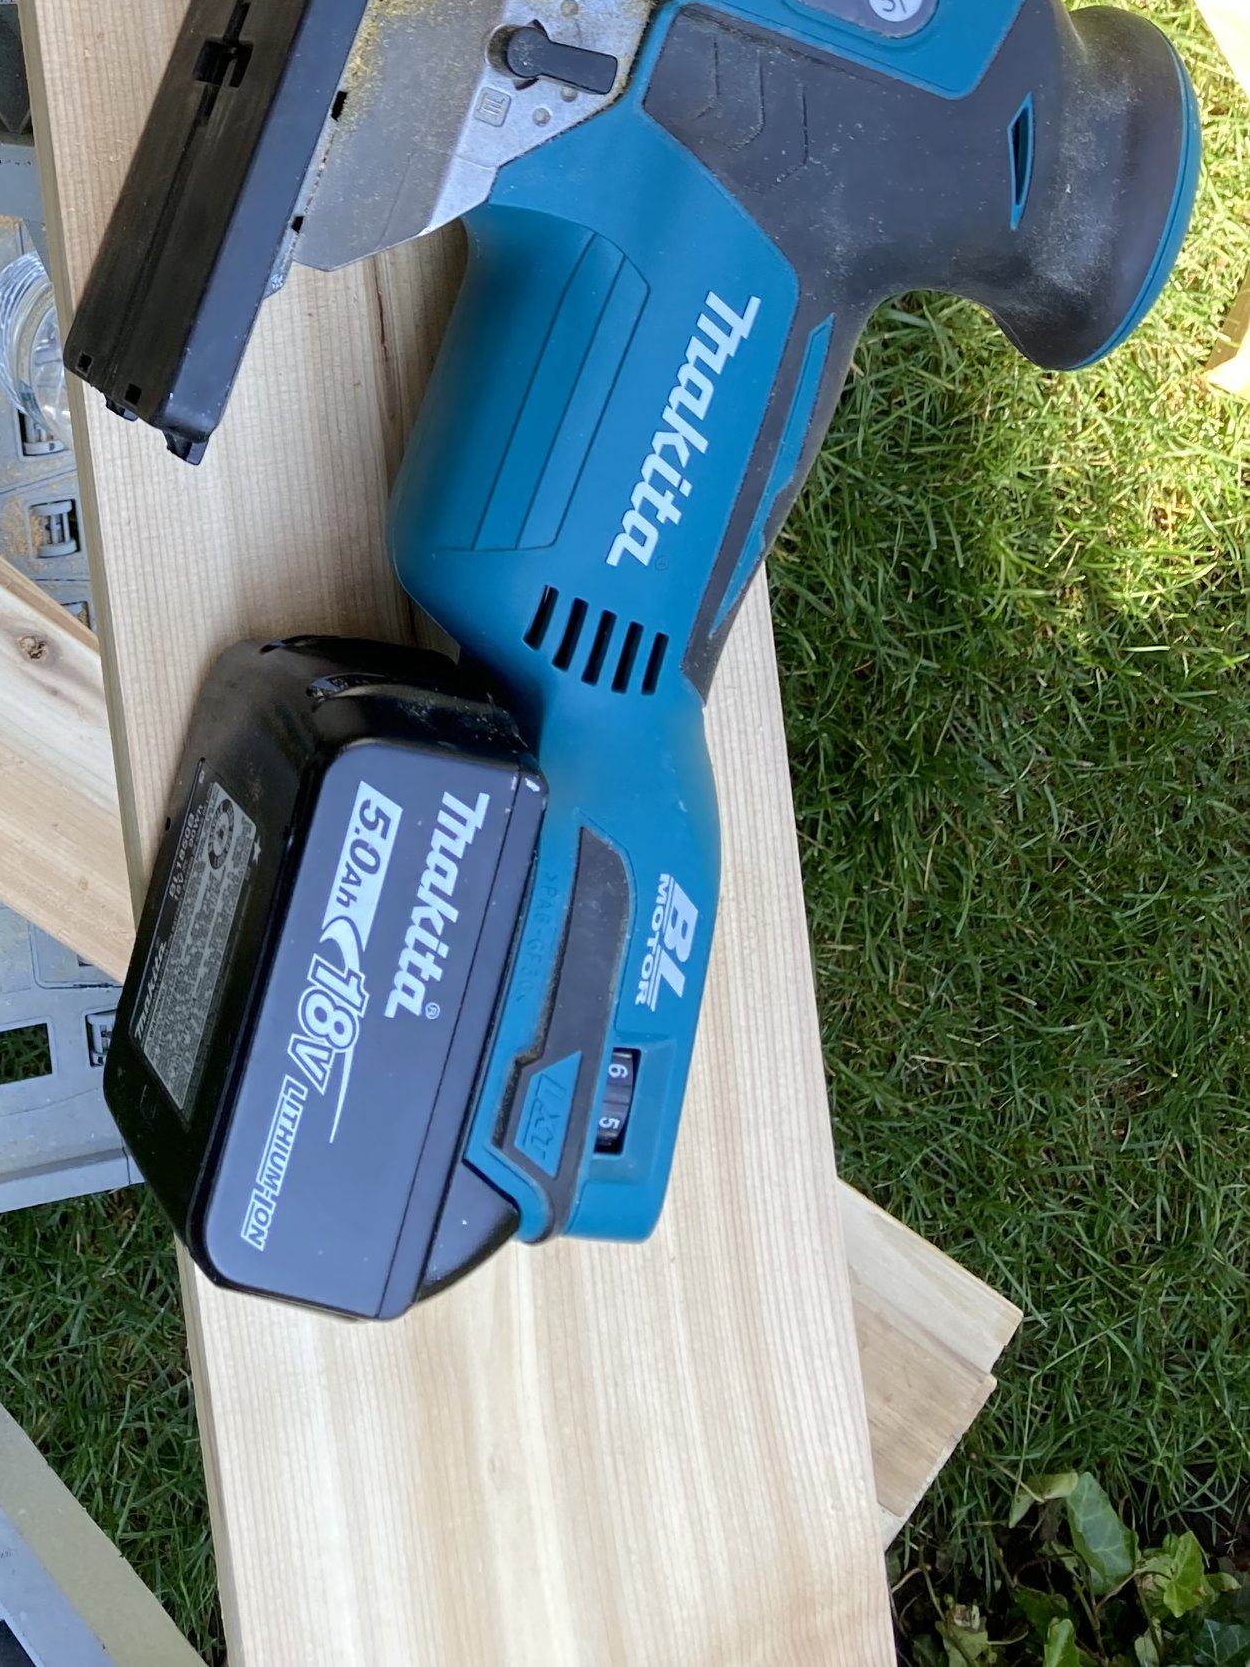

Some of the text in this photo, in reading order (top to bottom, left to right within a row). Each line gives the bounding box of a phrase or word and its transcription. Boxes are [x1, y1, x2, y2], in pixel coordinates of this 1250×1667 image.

[635, 873, 670, 1006] MOTOR
[649, 876, 699, 1012] BL
[287, 953, 370, 1096] 18V
[607, 1062, 629, 1079] 6
[598, 1116, 620, 1130] 5
